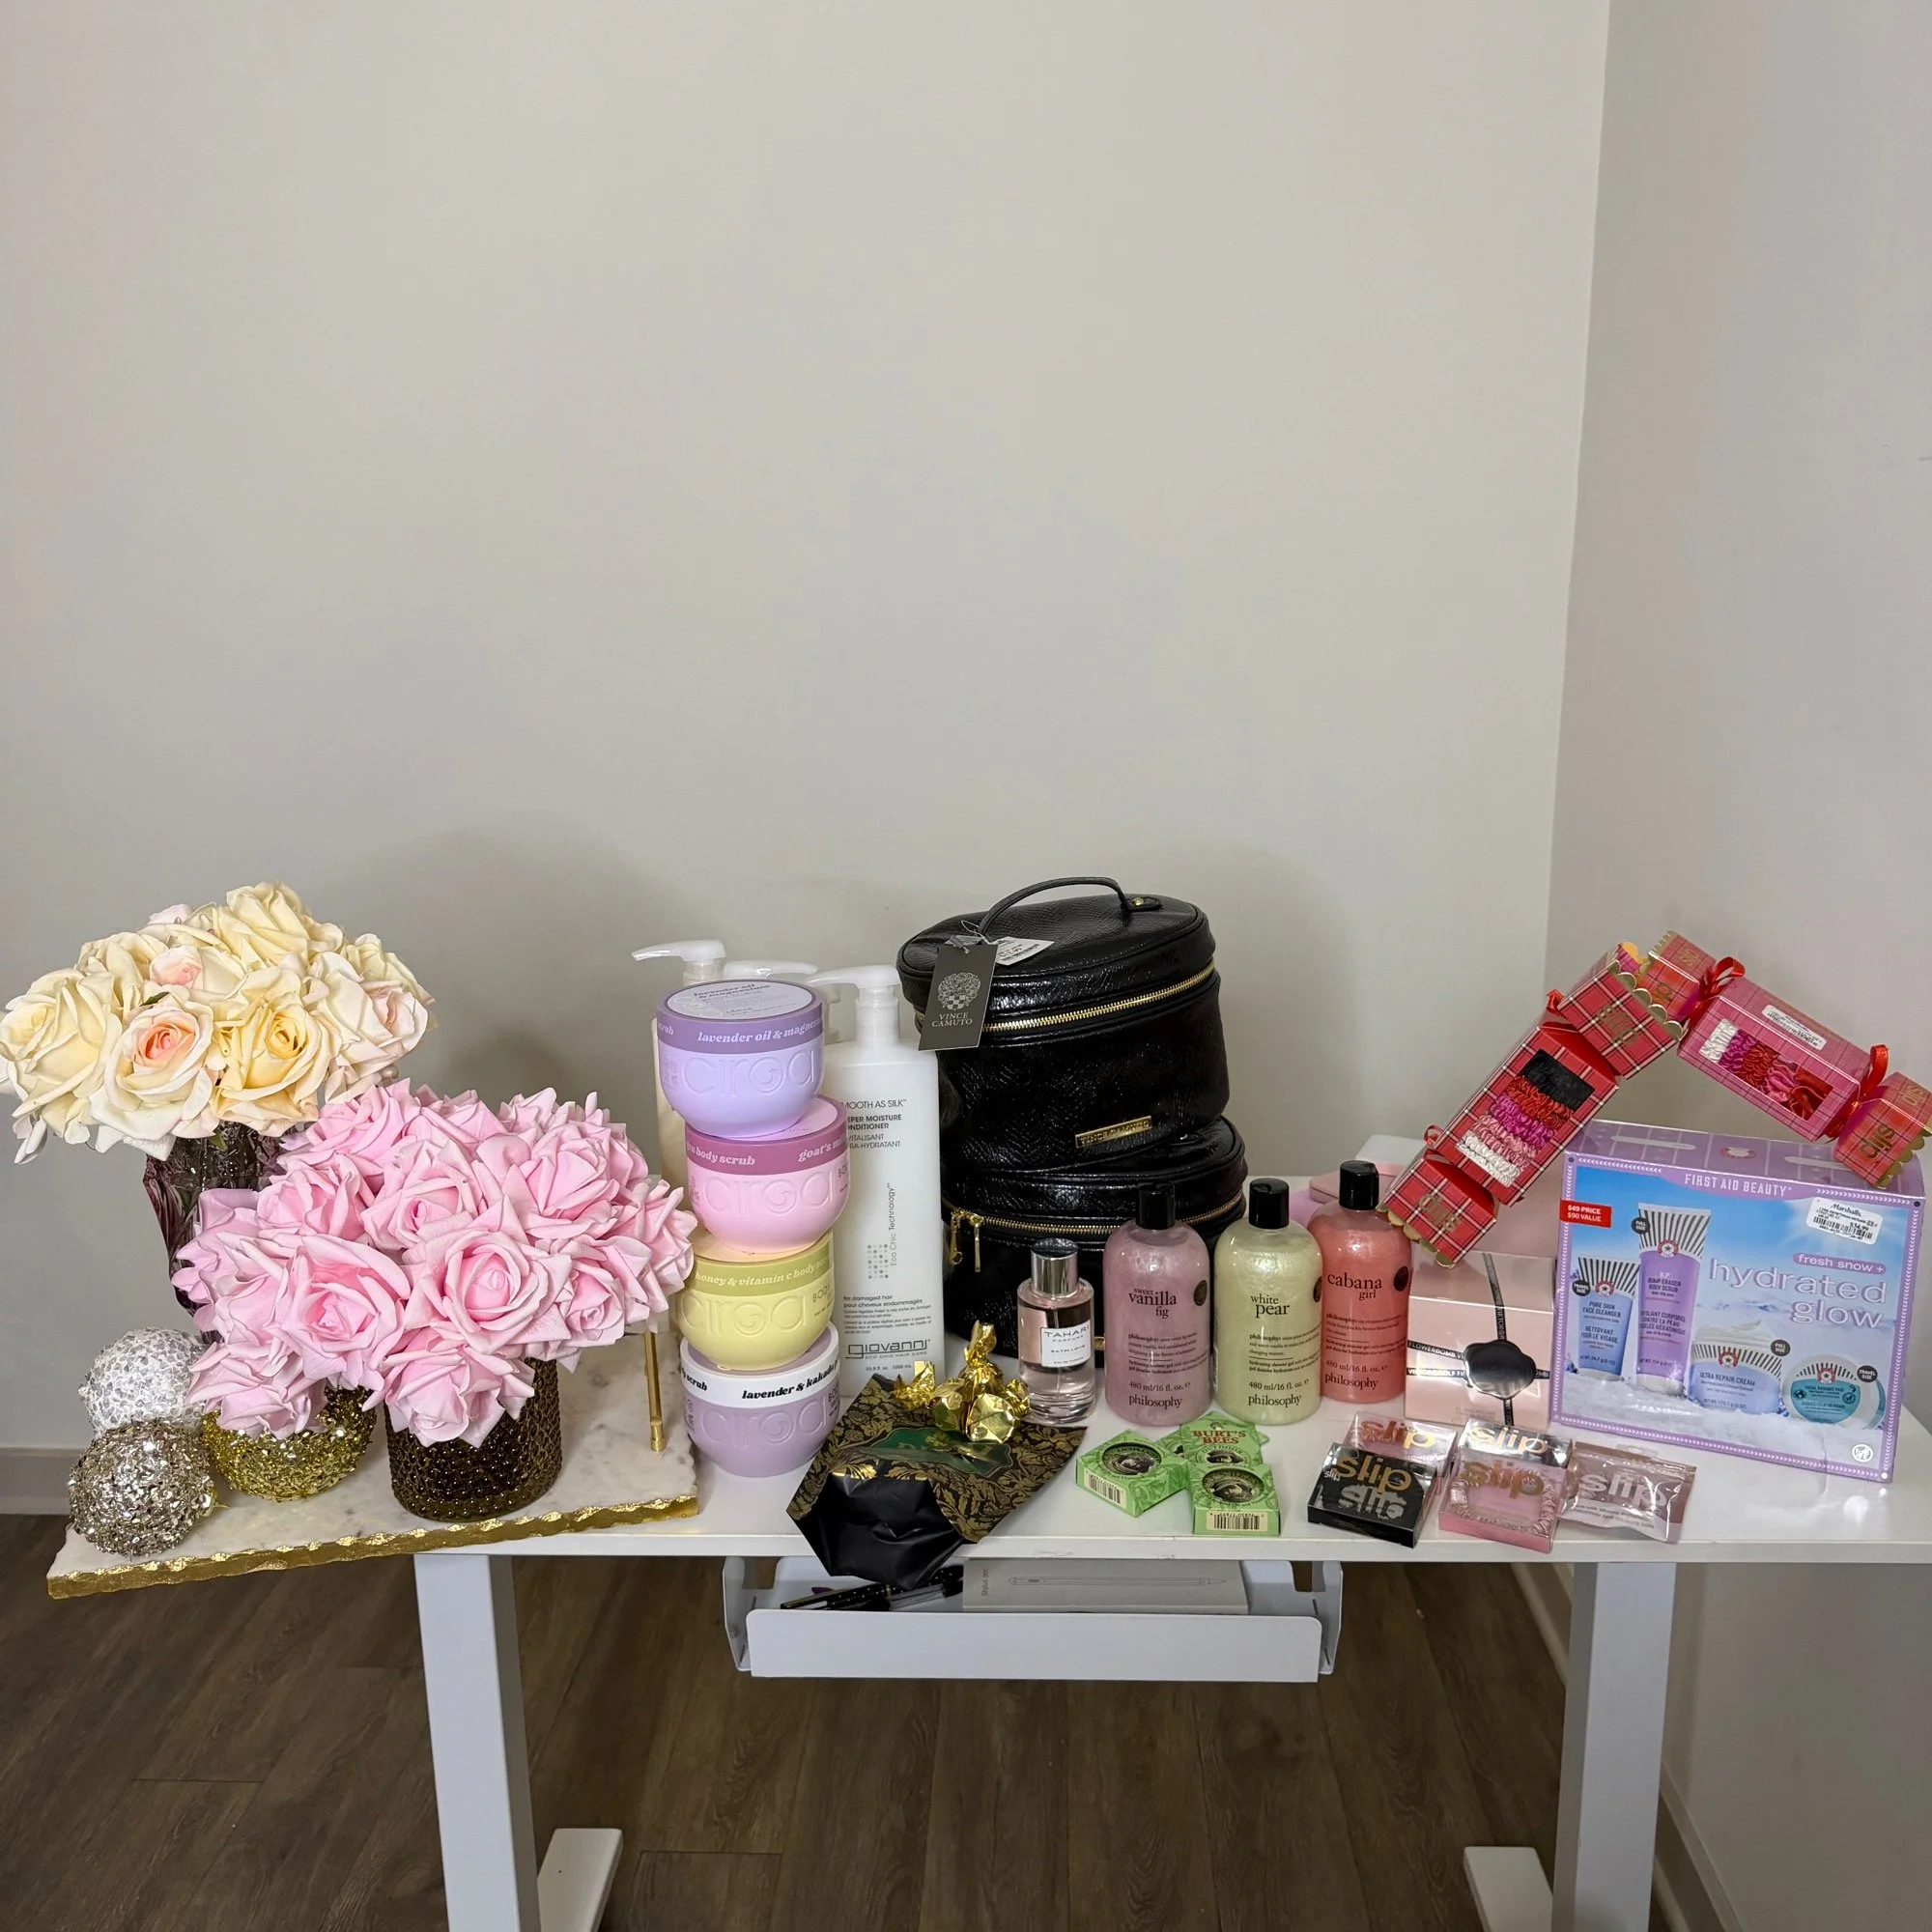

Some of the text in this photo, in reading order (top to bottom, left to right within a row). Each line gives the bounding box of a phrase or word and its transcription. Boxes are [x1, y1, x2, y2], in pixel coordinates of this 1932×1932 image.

[931, 1018, 973, 1028] CAMUTO
[938, 1011, 969, 1020] VINCE
[697, 1032, 753, 1043] lavender
[754, 1031, 772, 1042] oil
[773, 1030, 783, 1039] &
[841, 1100, 874, 1110] MOOTH
[875, 1099, 886, 1109] AS
[847, 1113, 902, 1123] EPER MOISTURE
[847, 1122, 890, 1131] NDITIONER
[696, 1149, 756, 1166] body scrub
[797, 1144, 833, 1162] goat's
[1684, 1173, 1719, 1189] FIRST
[1719, 1178, 1740, 1192] AID
[1580, 1206, 1602, 1215] PRICE
[1580, 1213, 1603, 1222] VALUE
[1798, 1254, 1833, 1267] fresh
[1837, 1260, 1874, 1272] snow
[695, 1272, 726, 1287] honey
[726, 1277, 739, 1287] &
[739, 1273, 784, 1287] vitamin
[792, 1264, 816, 1280] body
[1326, 1271, 1382, 1291] cabana
[1709, 1258, 1888, 1303] hydrated
[1128, 1291, 1178, 1306] vanilla
[1133, 1287, 1154, 1295] sweet
[1358, 1289, 1377, 1301] girl
[1250, 1293, 1280, 1305] white
[1154, 1307, 1170, 1320] fig
[1255, 1303, 1291, 1319] pear
[1789, 1299, 1884, 1328] glow
[1043, 1323, 1090, 1338] TAHARI
[845, 1339, 928, 1359] giovanni
[1407, 1340, 1457, 1359] FLOWERBOMB
[686, 1374, 708, 1392] scrub
[742, 1364, 835, 1400] lavender & kakadu
[1128, 1380, 1142, 1391] 480
[1143, 1381, 1164, 1392] ml/16
[1248, 1380, 1263, 1390] 480
[1264, 1380, 1285, 1391] ml/16
[1324, 1372, 1379, 1390] philosophy
[1128, 1395, 1183, 1410] philosophy
[1247, 1393, 1302, 1408] philosophy
[1190, 1430, 1247, 1438] BURT'S
[1203, 1436, 1240, 1445] BEES
[1360, 1420, 1436, 1450] slip
[1471, 1426, 1548, 1454] slip
[1323, 1470, 1341, 1482] slip
[1331, 1455, 1412, 1493] slip
[1459, 1460, 1546, 1499] slip
[1579, 1472, 1668, 1510] slip
